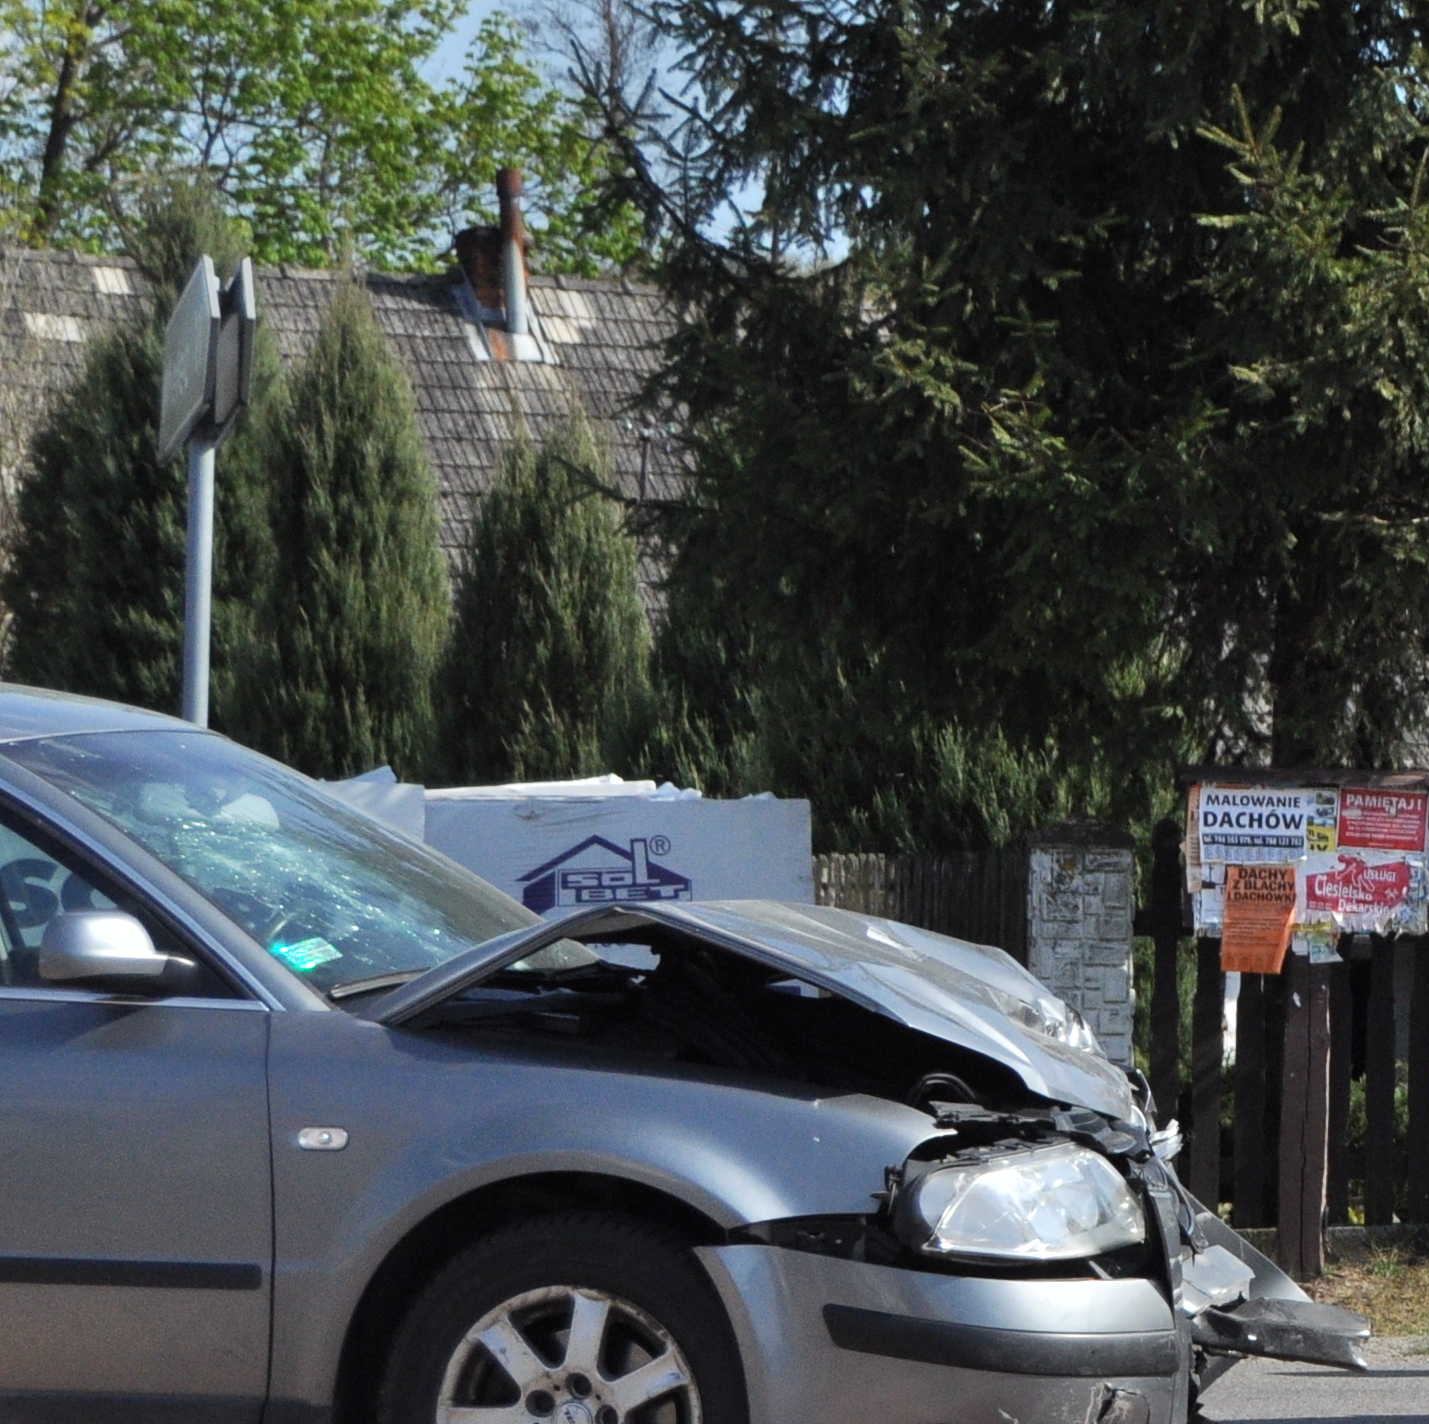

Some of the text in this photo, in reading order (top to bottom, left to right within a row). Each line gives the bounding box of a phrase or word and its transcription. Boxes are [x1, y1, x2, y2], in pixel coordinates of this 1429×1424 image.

[1206, 794, 1301, 808] MALOWANIE
[1203, 809, 1304, 830] DACHÓW
[1239, 868, 1287, 880] DACHY
[1363, 869, 1397, 882] USŁUGI
[1233, 880, 1296, 892] Z BLACHY
